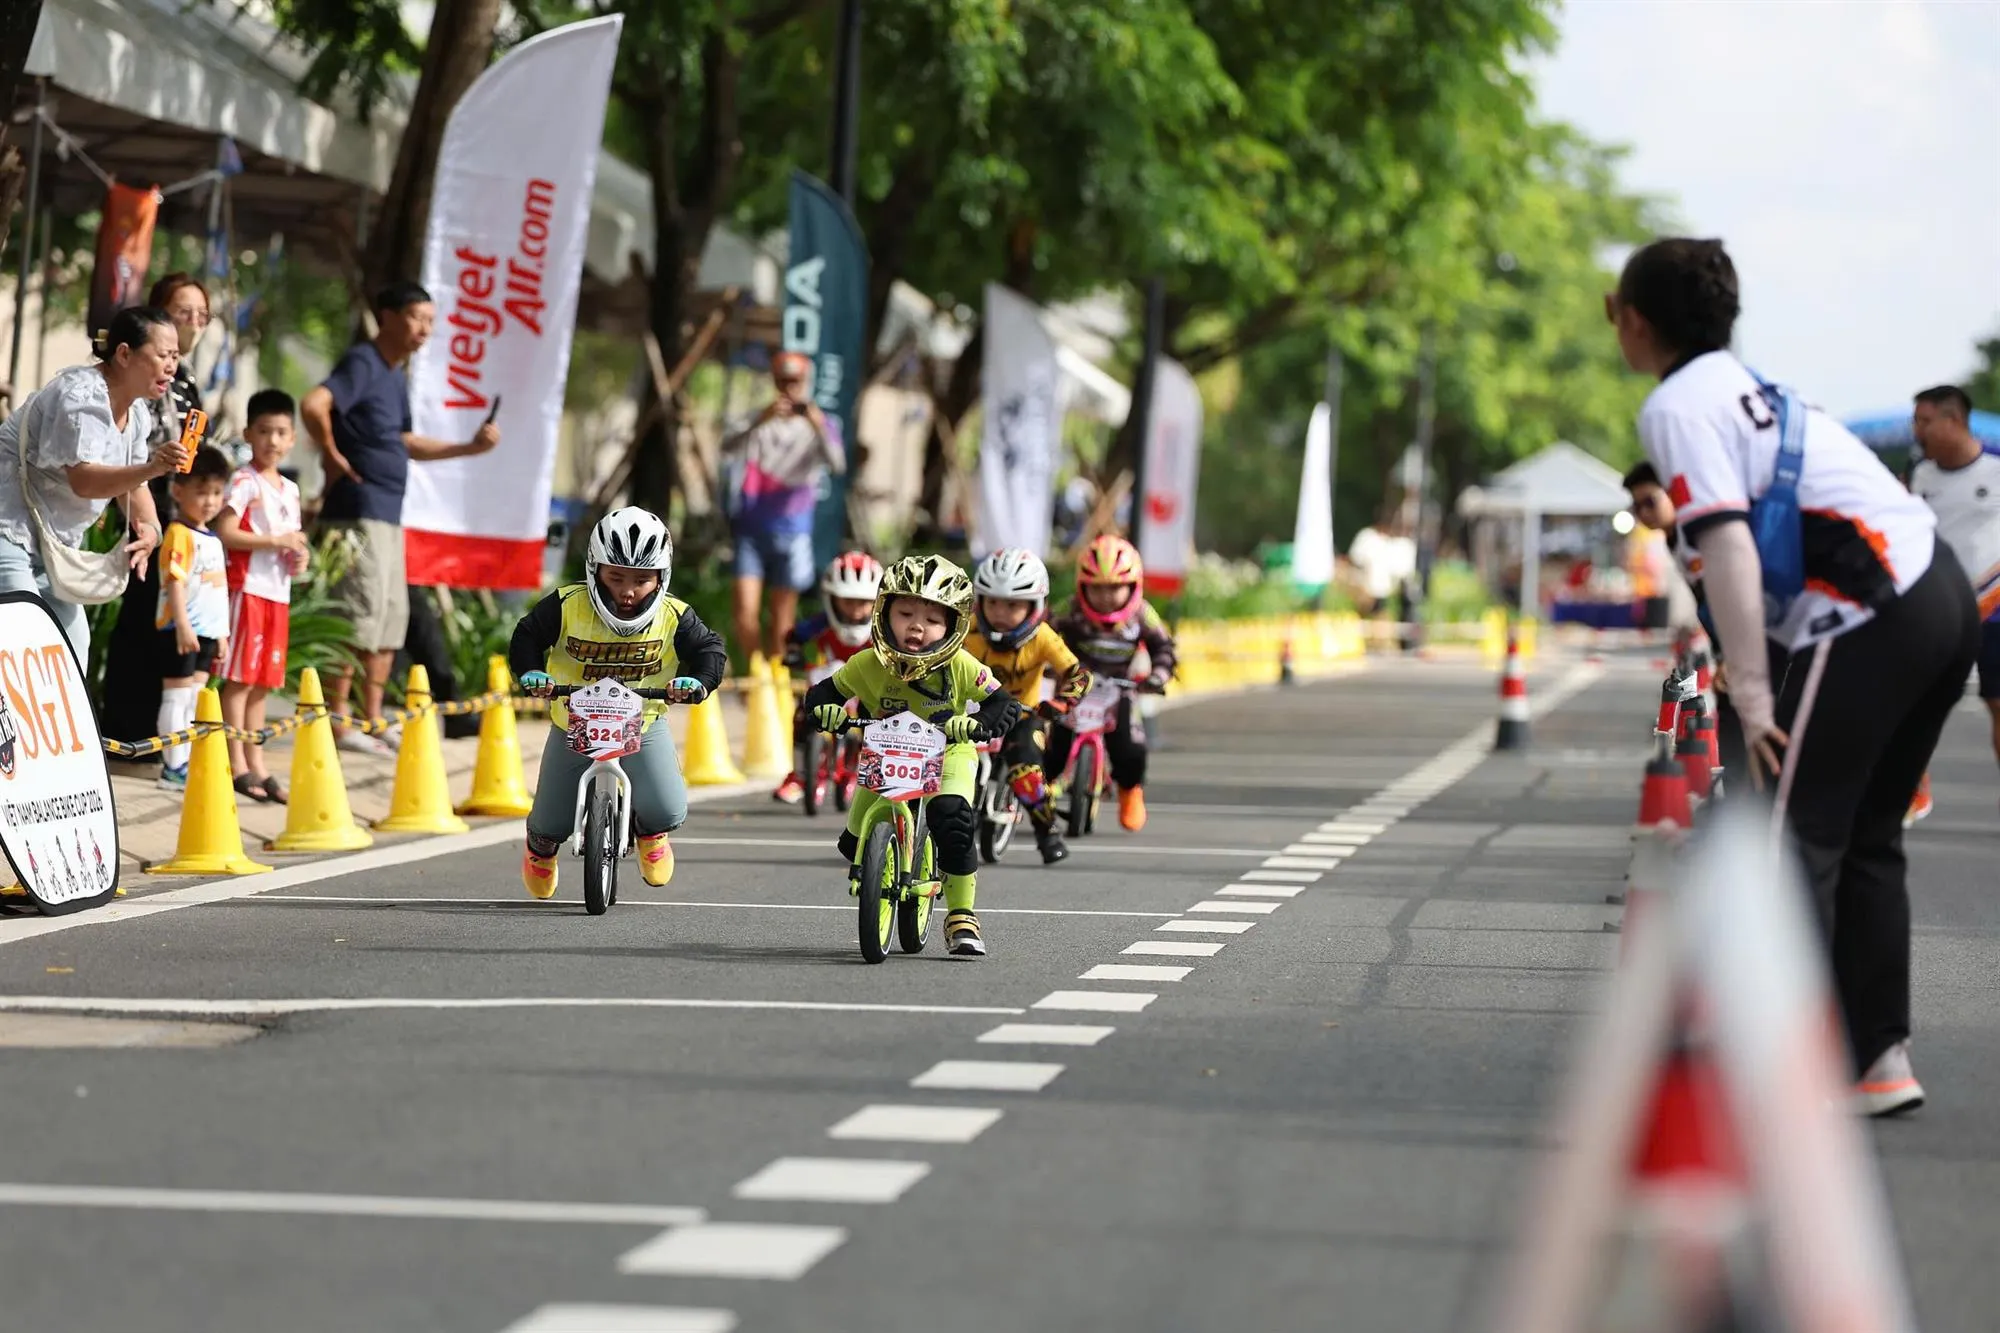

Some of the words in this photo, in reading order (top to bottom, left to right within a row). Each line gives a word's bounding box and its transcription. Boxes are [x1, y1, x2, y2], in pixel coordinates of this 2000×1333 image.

[565, 636, 663, 664] SPIDER
[0, 644, 84, 760] SGT
[589, 728, 622, 743] 324
[884, 763, 920, 780] 303
[31, 796, 63, 823] BALANCE
[59, 794, 77, 818] BIKE
[74, 792, 88, 816] CUP
